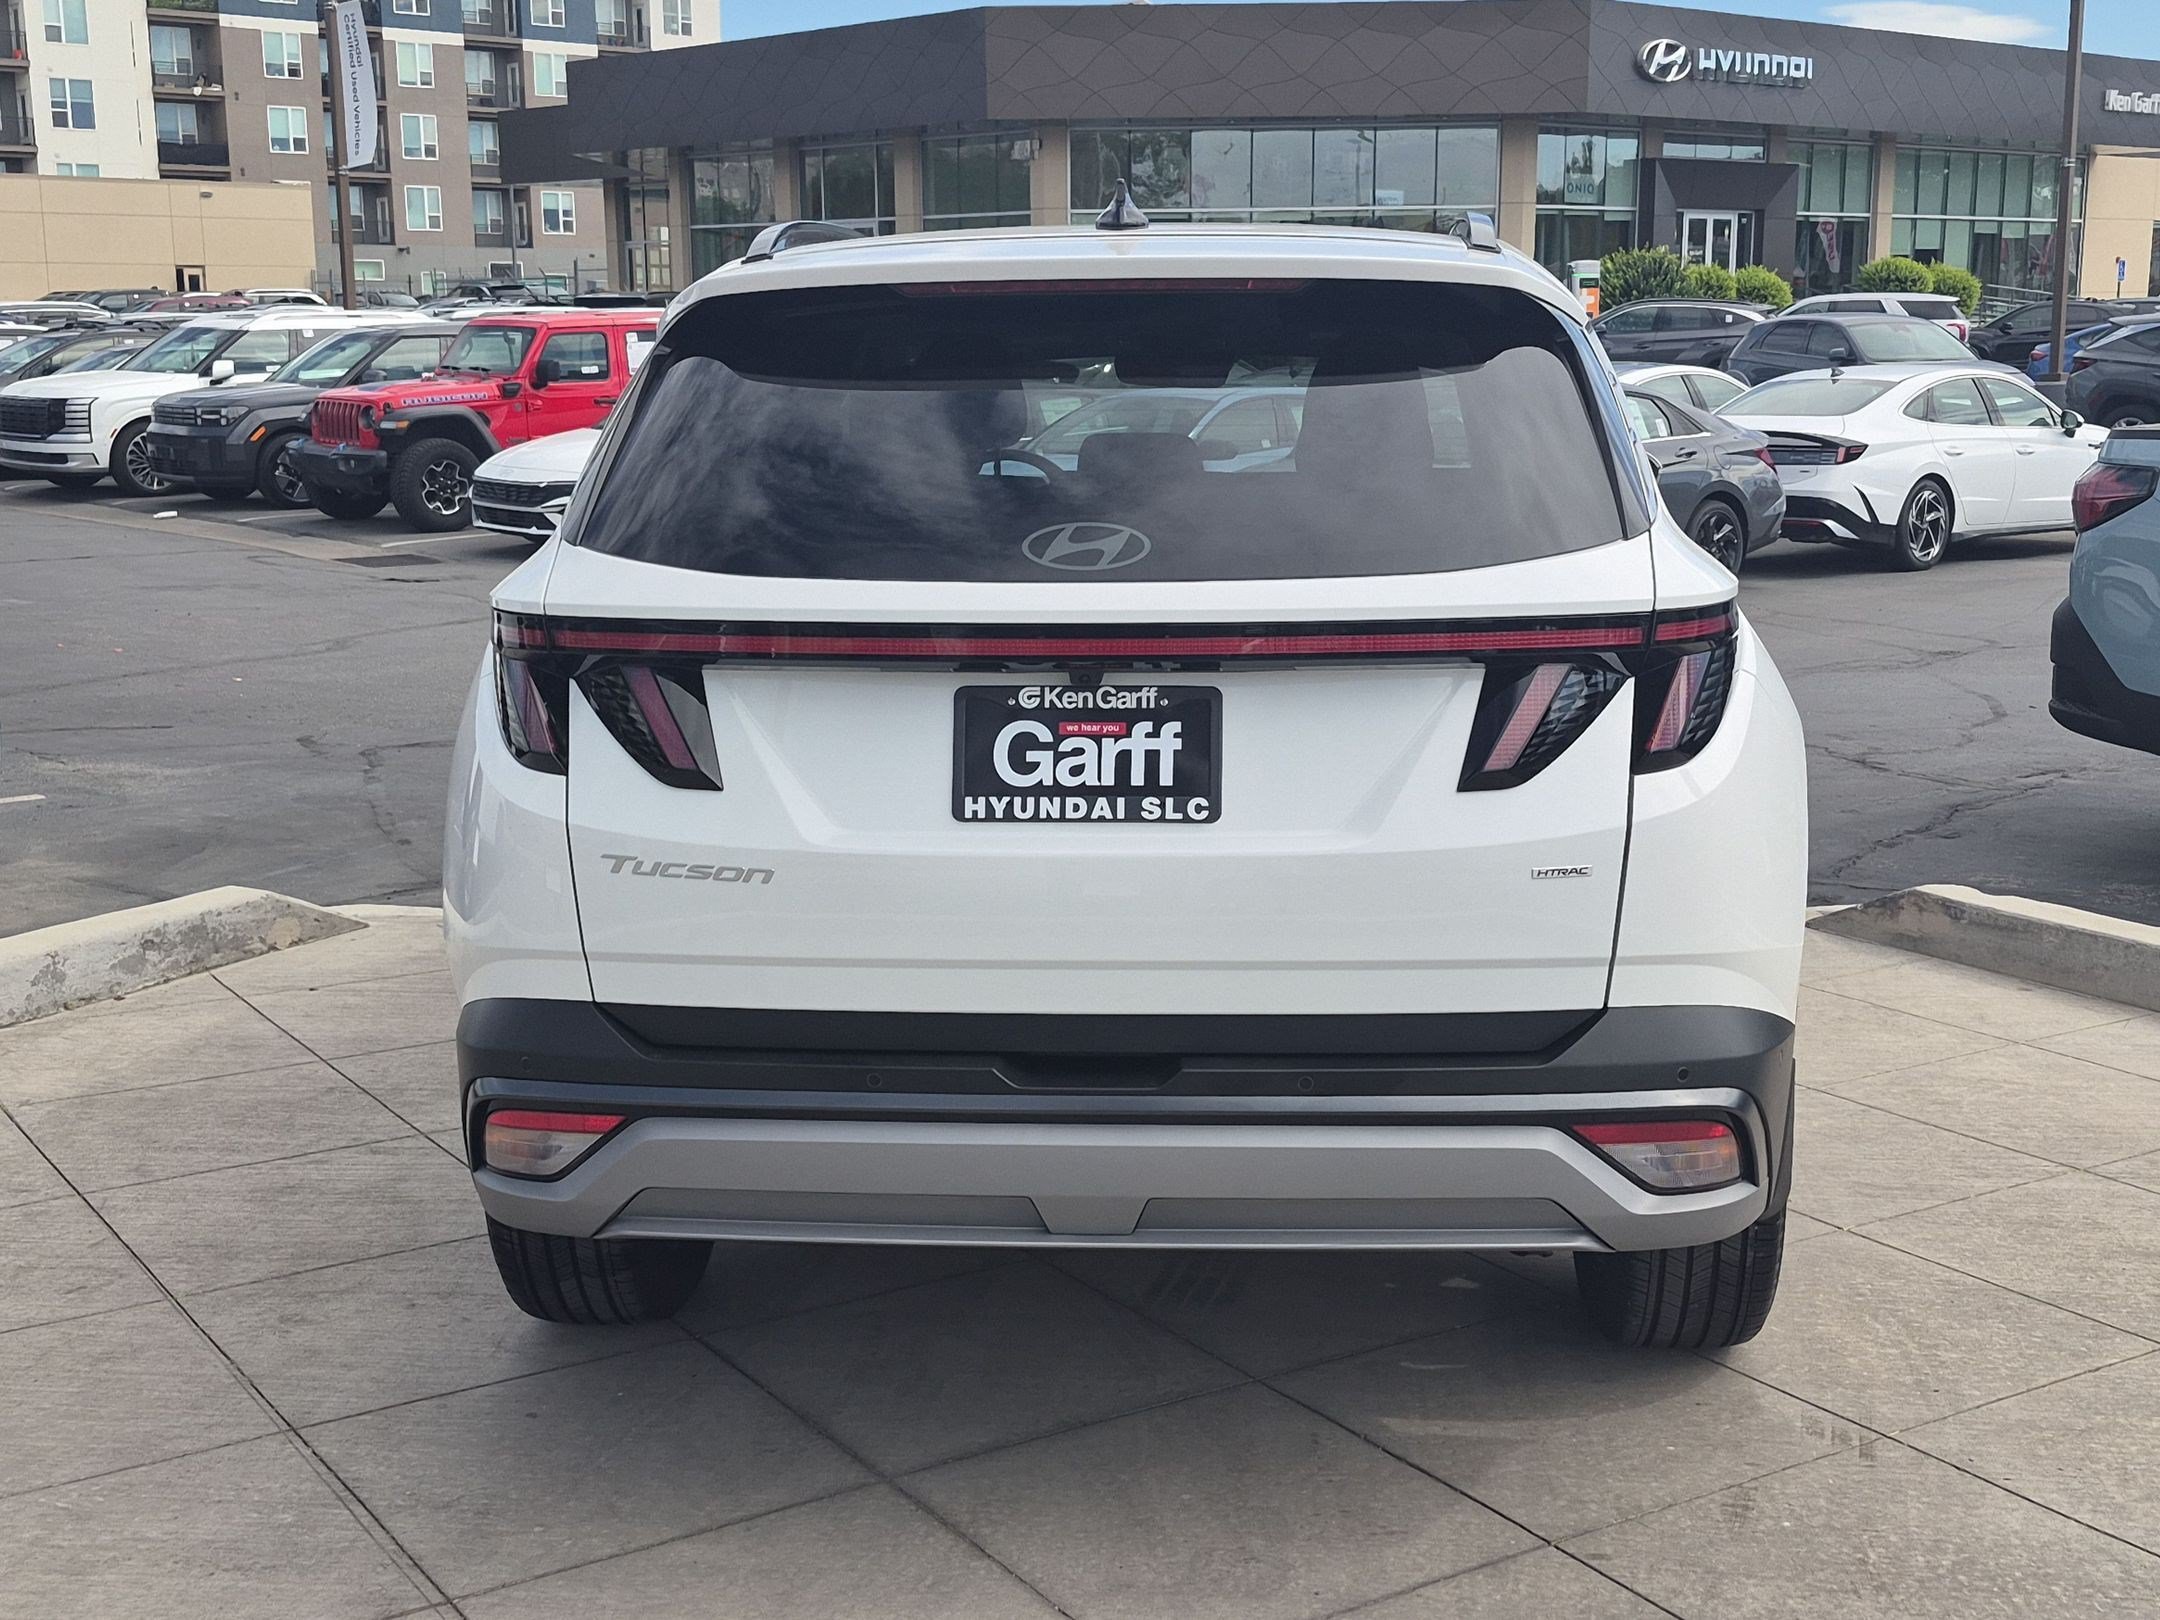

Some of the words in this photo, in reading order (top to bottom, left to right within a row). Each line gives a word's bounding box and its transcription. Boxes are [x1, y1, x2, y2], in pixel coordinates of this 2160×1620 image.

[343, 14, 357, 69] Certified
[349, 12, 364, 67] Hyundai
[1698, 47, 1814, 87] HYUNDAI
[350, 71, 360, 103] Used
[2105, 89, 2131, 112] Ken
[353, 105, 361, 156] Vehicles
[1044, 686, 1093, 709] Ken
[1096, 686, 1158, 710] Garff
[1081, 723, 1100, 732] hear
[1102, 725, 1120, 736] you
[993, 719, 1182, 788] Garff
[964, 796, 1126, 820] HYUNDAI
[1140, 796, 1211, 821] SLC
[1536, 866, 1589, 878] HTRAC
